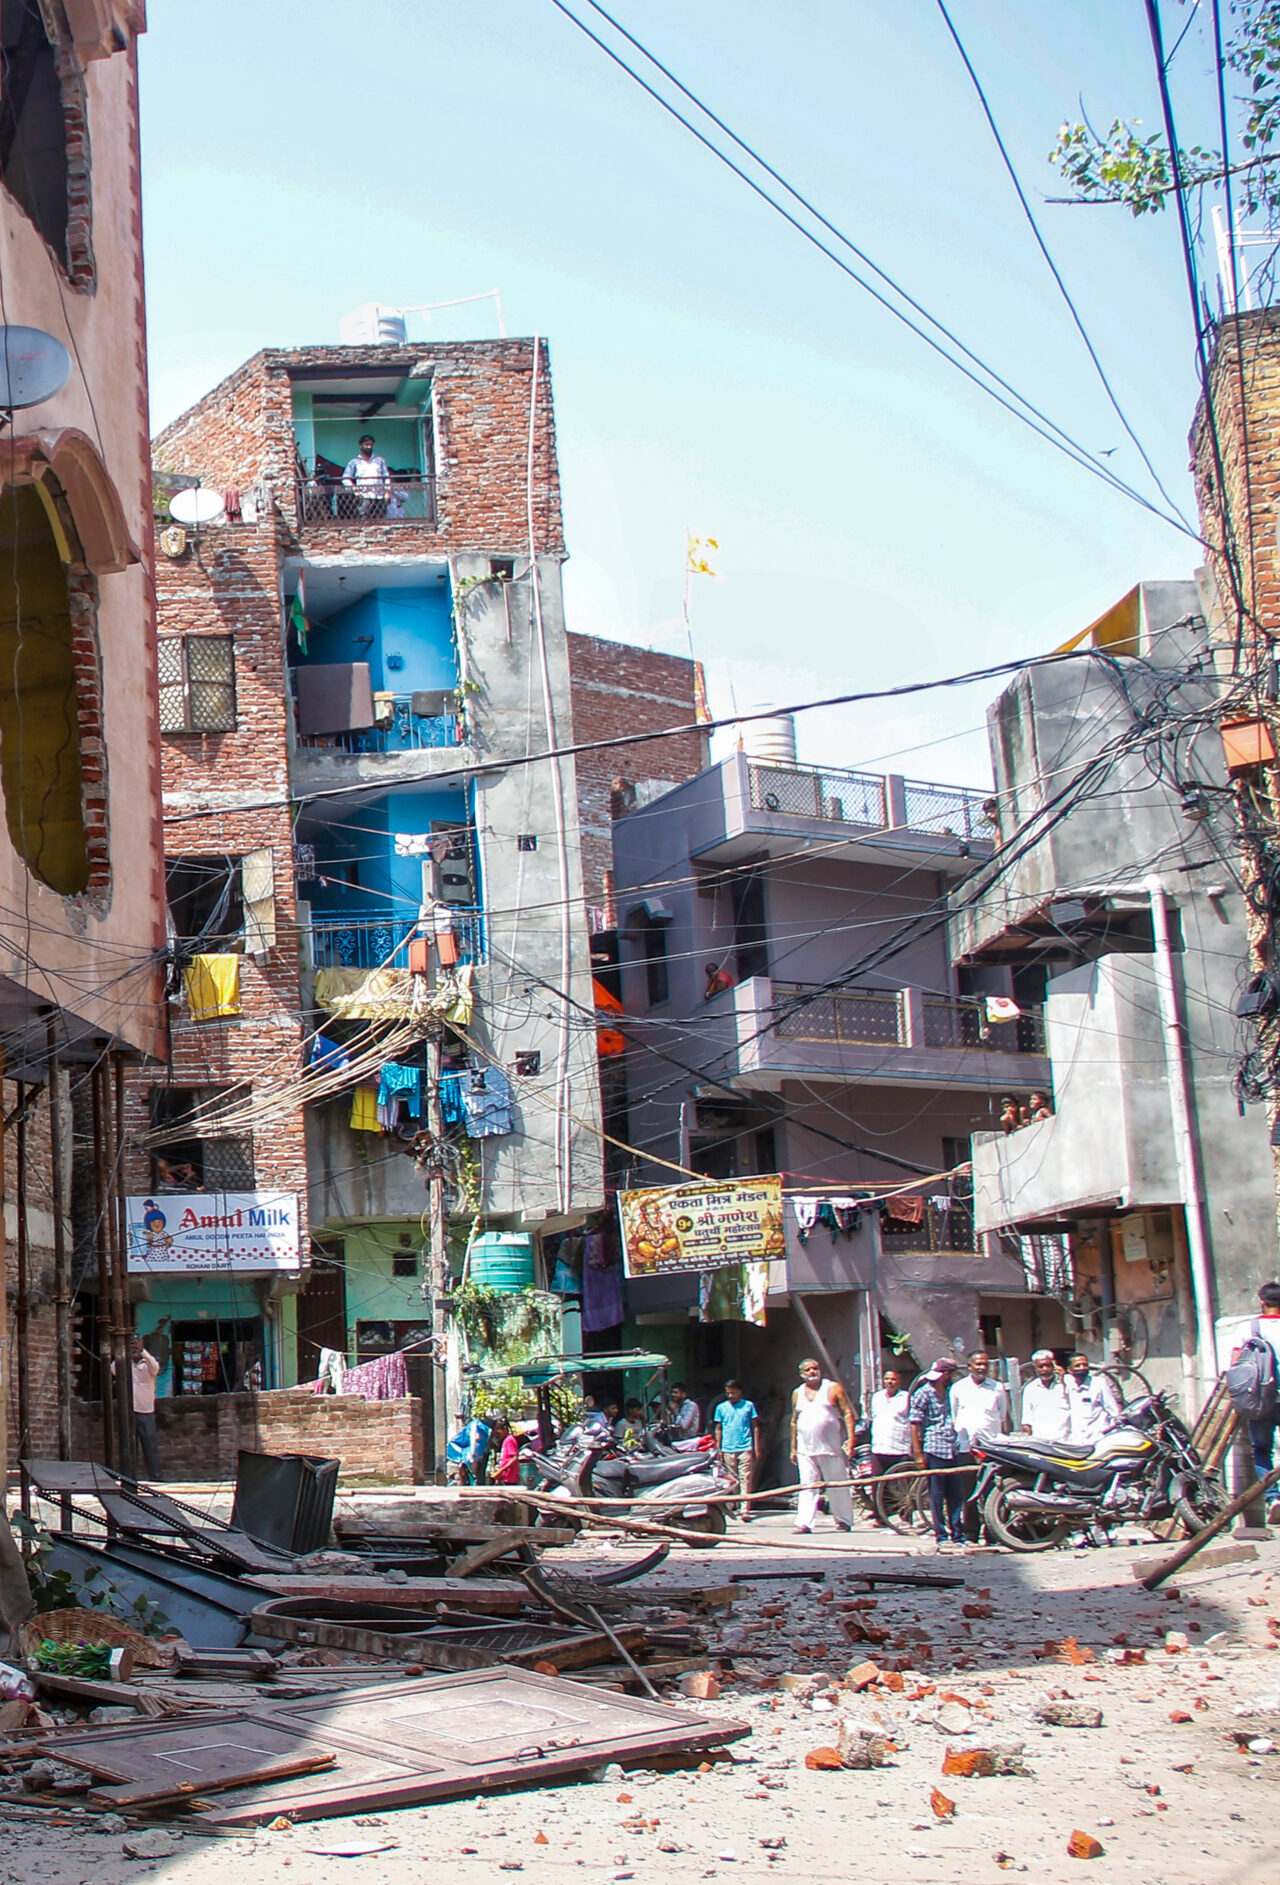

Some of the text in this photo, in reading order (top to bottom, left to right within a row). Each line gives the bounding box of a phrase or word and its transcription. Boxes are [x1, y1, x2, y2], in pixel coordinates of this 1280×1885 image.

[669, 1198, 703, 1209] एकता
[706, 1193, 731, 1205] मित्र
[736, 1190, 768, 1202] मंडल
[179, 1208, 290, 1229] Amul Milk
[697, 1209, 759, 1226] श्री गणेश
